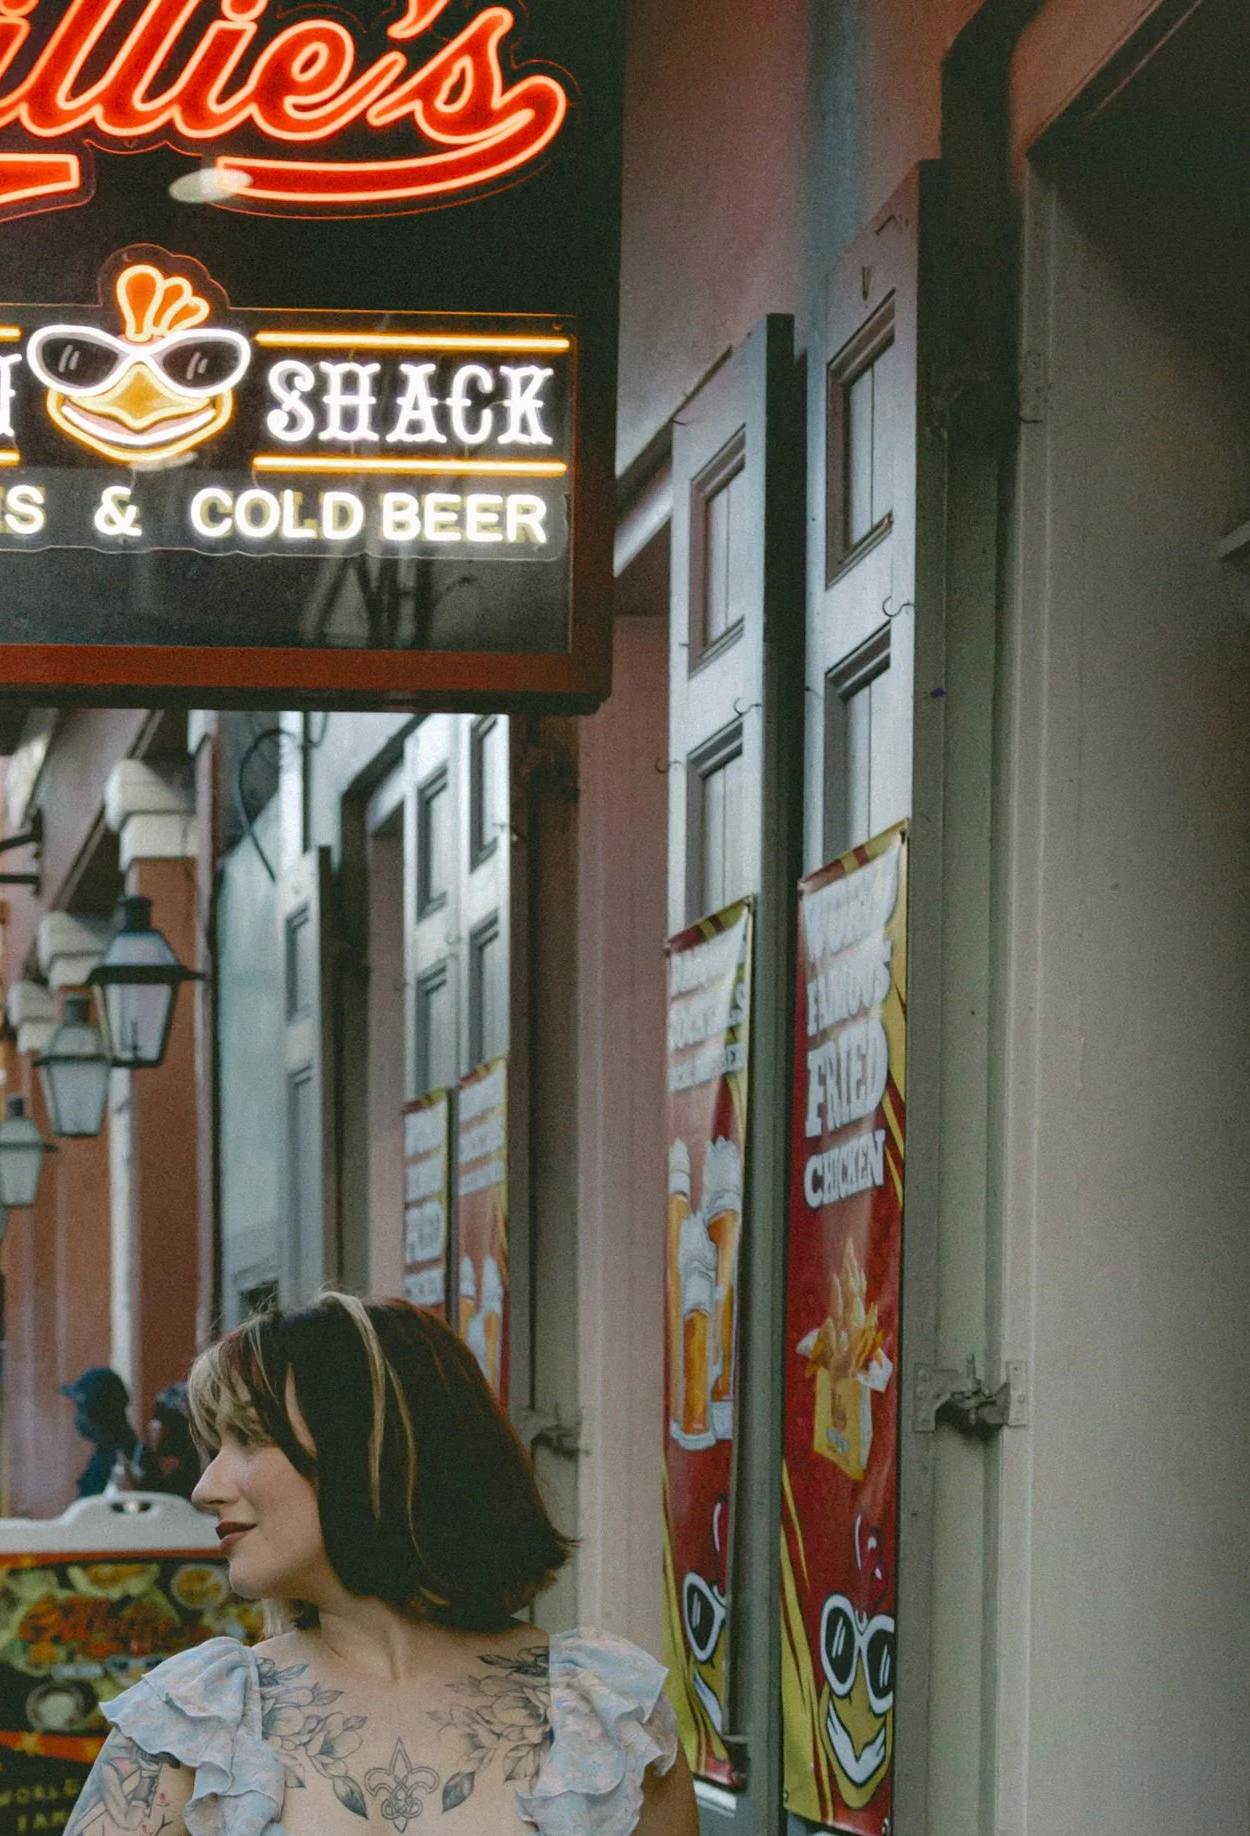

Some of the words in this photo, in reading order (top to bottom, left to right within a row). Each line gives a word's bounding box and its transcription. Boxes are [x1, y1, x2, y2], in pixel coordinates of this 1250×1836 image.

[265, 361, 554, 447] SHACK
[92, 484, 142, 539] &
[190, 486, 364, 543] COLD
[379, 491, 550, 545] BEER
[805, 1021, 890, 1138] FRIED
[804, 1129, 886, 1209] CHICKEN
